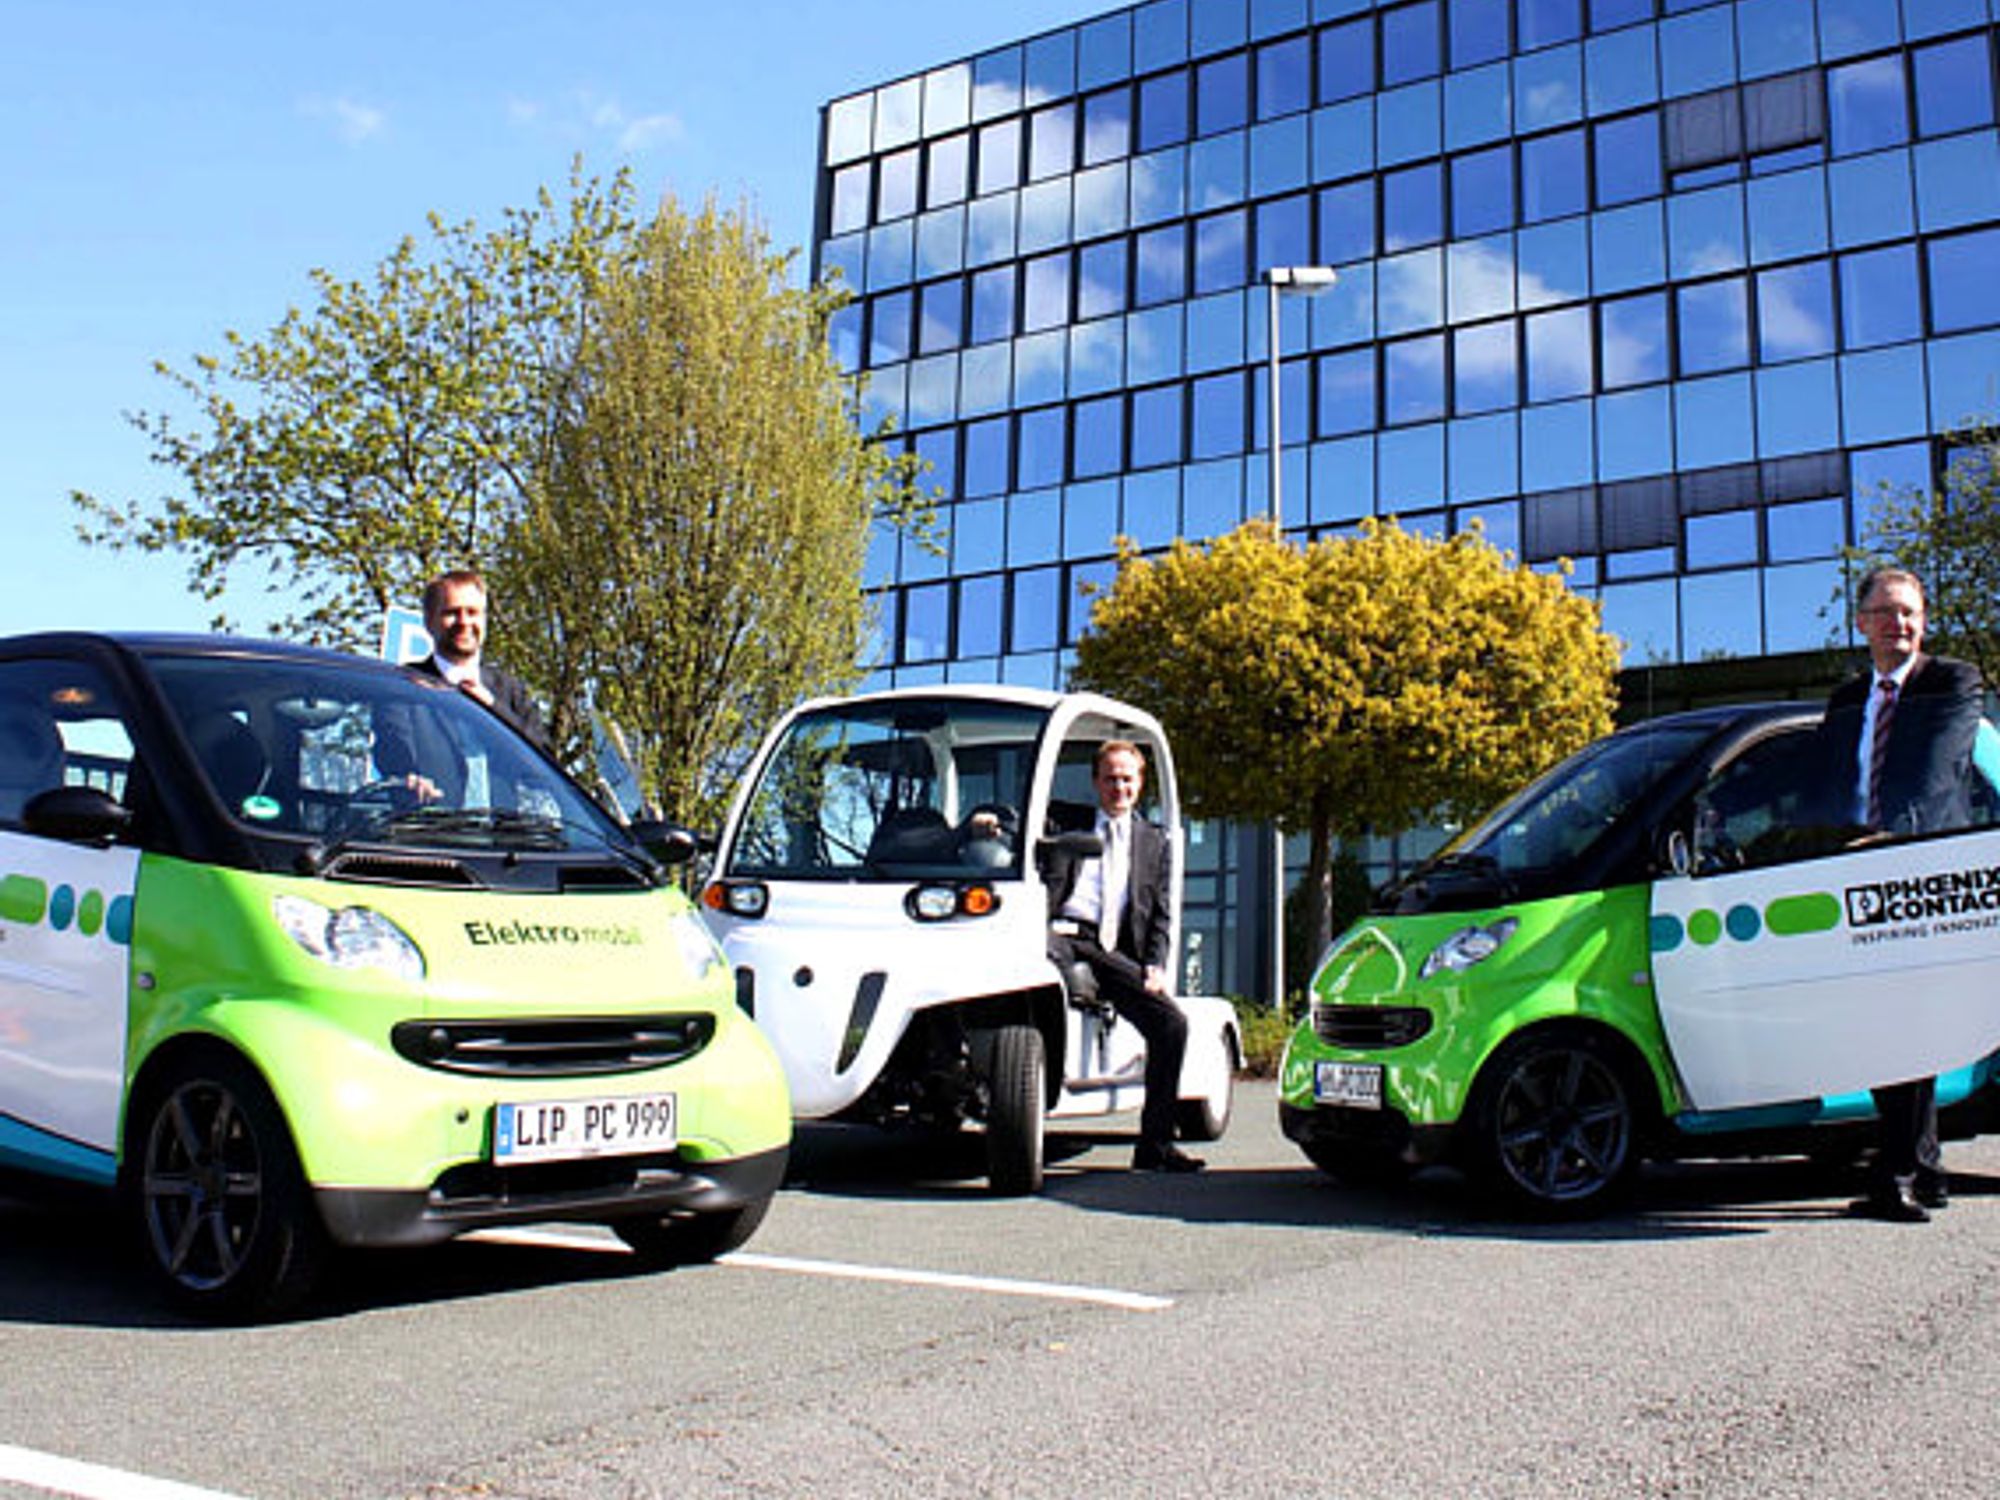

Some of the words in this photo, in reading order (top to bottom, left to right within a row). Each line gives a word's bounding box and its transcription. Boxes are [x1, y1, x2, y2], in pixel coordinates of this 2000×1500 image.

[516, 1105, 566, 1147] LIP
[585, 1102, 618, 1141] PC
[626, 1099, 671, 1139] 999
